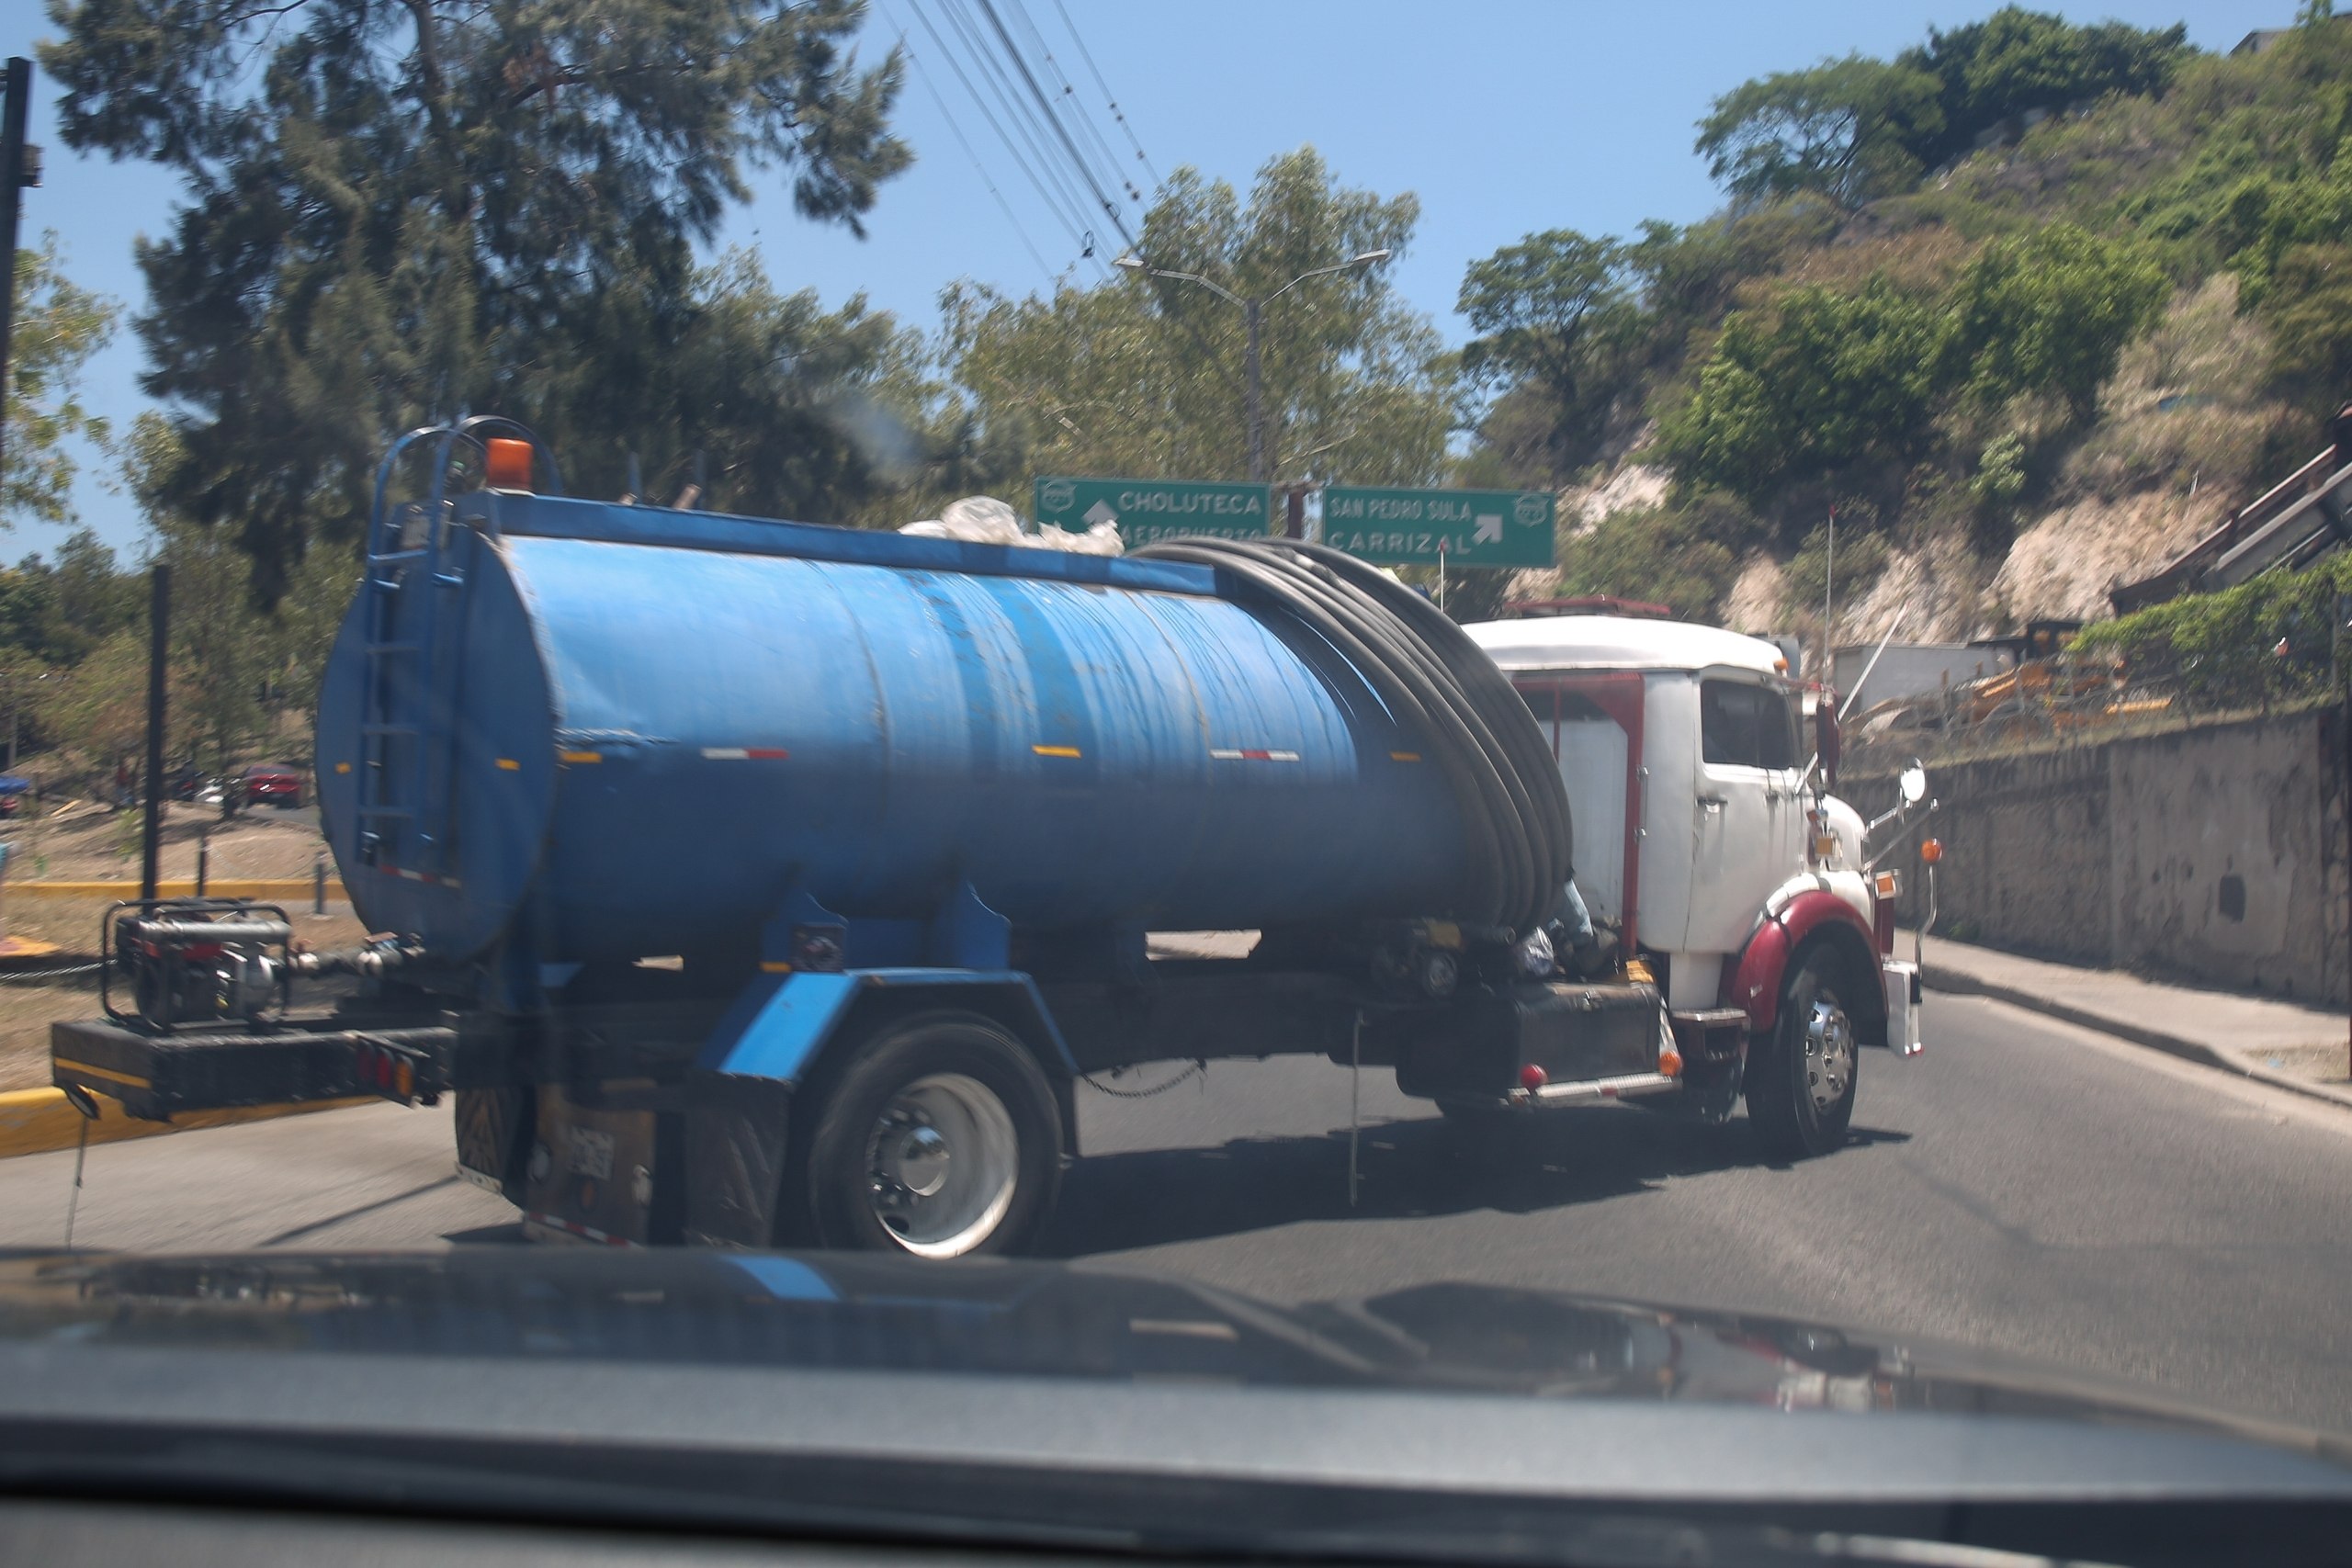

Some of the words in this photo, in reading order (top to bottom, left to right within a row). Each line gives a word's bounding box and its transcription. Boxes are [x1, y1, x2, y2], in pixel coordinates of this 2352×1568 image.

[1118, 491, 1261, 514] CHOLUTECA
[1329, 498, 1364, 517] SAN
[1369, 500, 1423, 520] PEDRO
[1429, 501, 1472, 521] SULA
[1329, 532, 1472, 554] CARRIZAL
